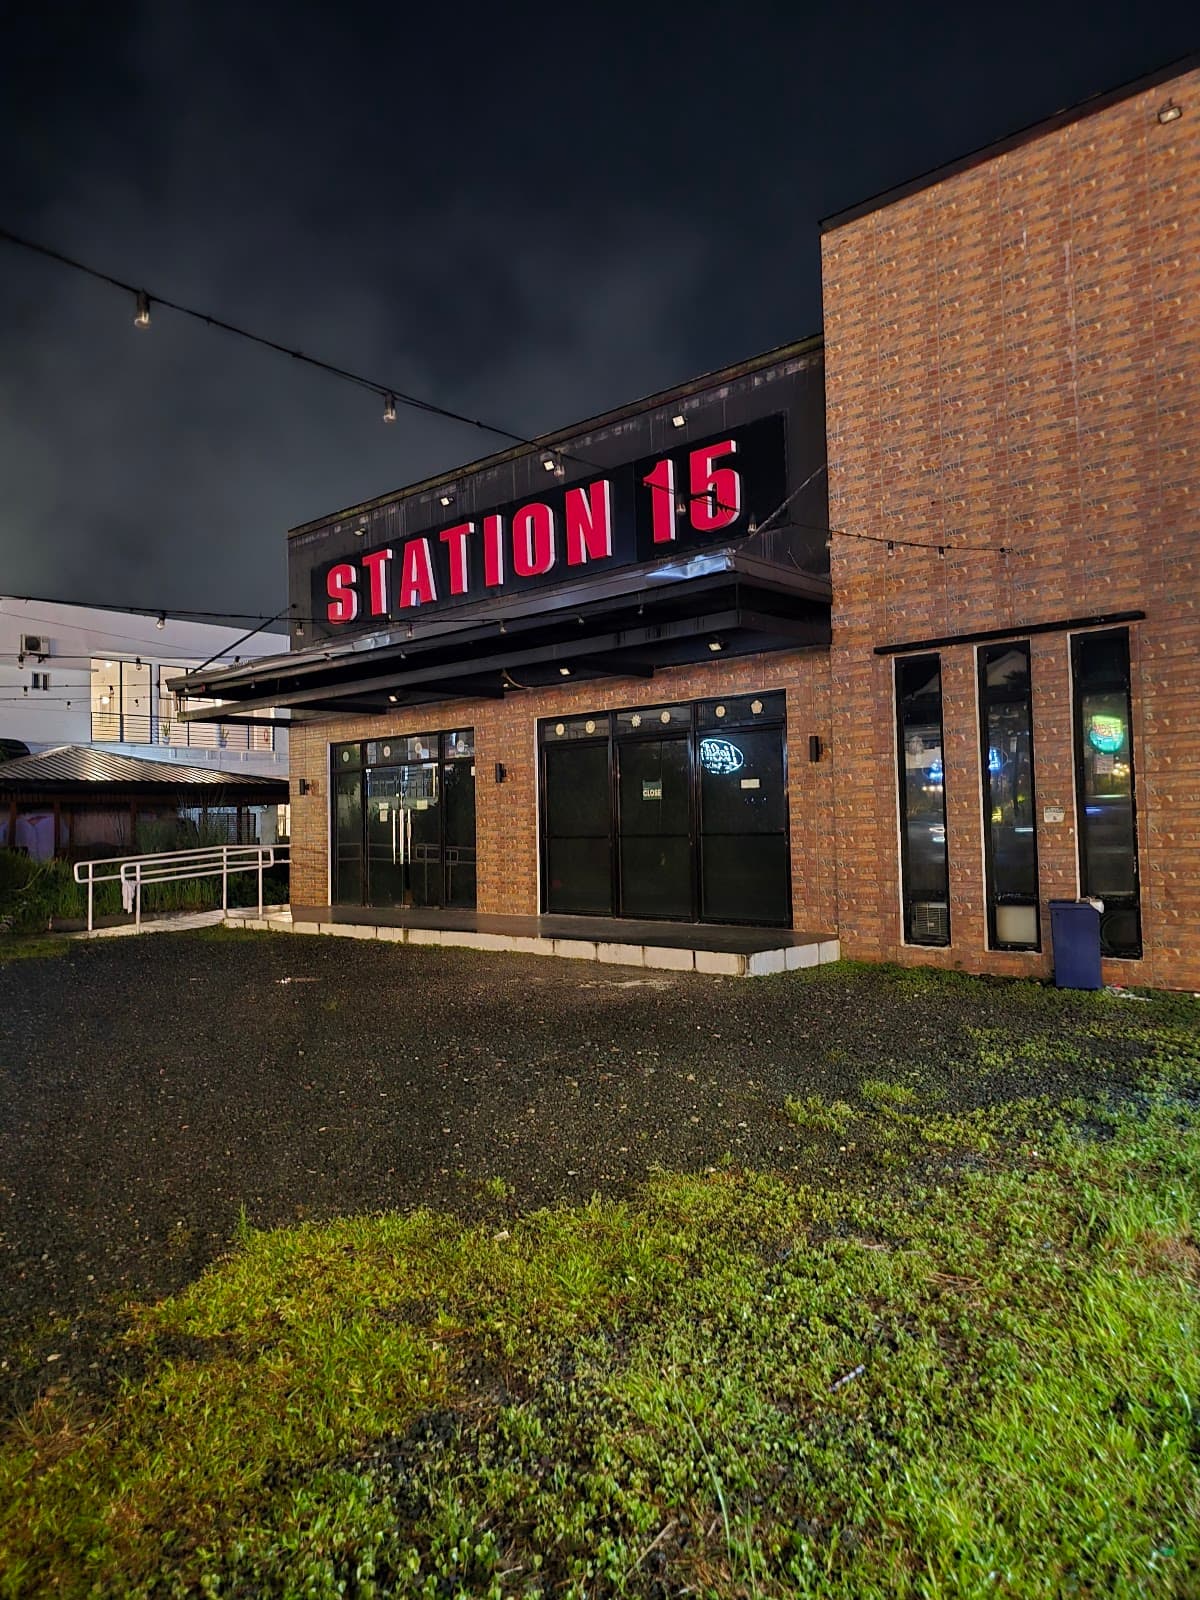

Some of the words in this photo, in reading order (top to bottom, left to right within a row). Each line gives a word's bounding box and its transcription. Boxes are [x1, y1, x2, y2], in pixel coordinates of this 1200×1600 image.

[326, 479, 613, 624] STATION
[642, 440, 741, 544] 15
[643, 788, 662, 797] CLOSE
